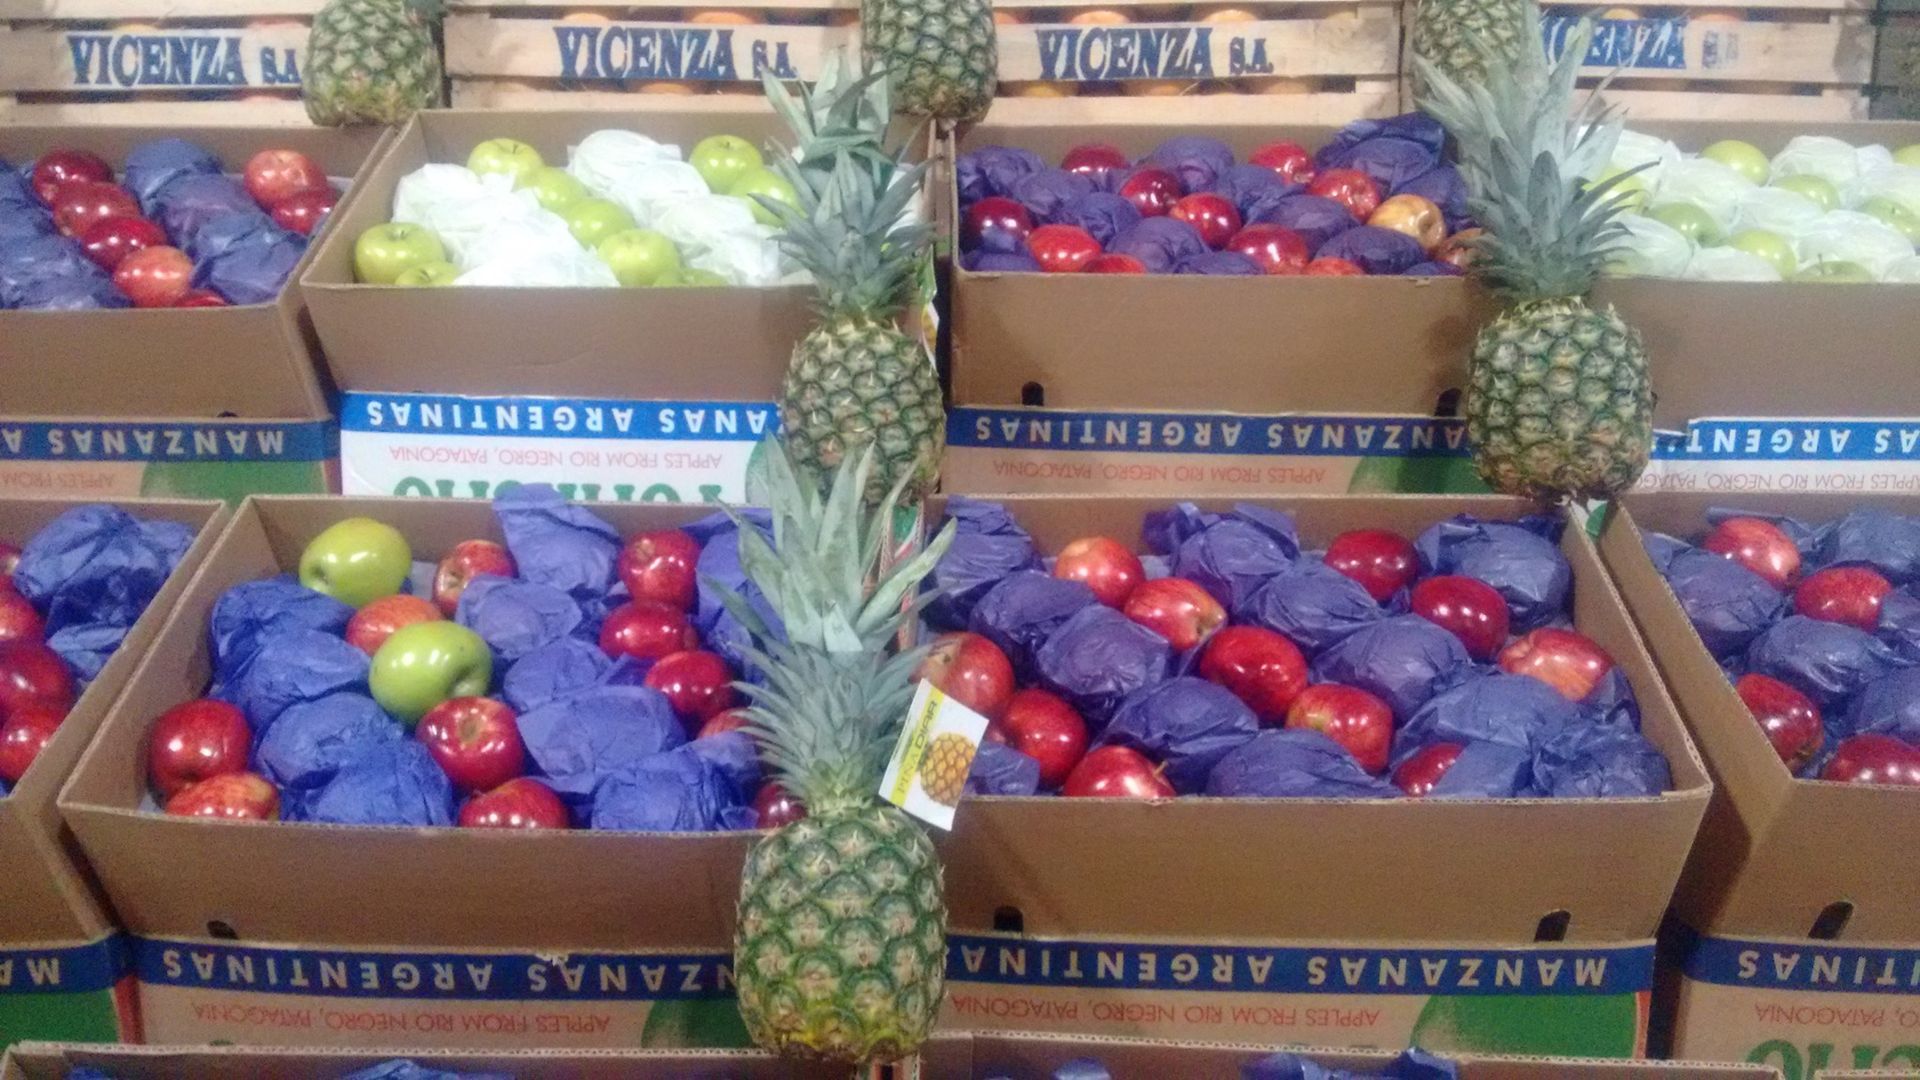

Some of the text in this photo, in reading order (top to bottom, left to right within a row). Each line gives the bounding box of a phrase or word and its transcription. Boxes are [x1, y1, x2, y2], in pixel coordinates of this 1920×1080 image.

[67, 34, 249, 87] VICENZA
[553, 26, 740, 80] VICENZA
[1036, 27, 1214, 80] VICENZA
[368, 400, 783, 434] ANAS ARGENTINAS
[975, 415, 1242, 447] ARGENTINAS
[49, 429, 285, 455] MANZANAS
[389, 445, 723, 469] APPLES FROM RIO NEGRO, PATAGONIA
[993, 460, 1326, 484] APPLES FROM RIO NEGRO, PATAGONIA
[1704, 472, 1773, 490] NEGRO,
[1778, 473, 1808, 490] RIO
[1814, 473, 1865, 490] FROM
[164, 949, 493, 992] ARGENTINAS
[1306, 955, 1608, 987] MANZANAS
[192, 1001, 611, 1034] APPLES FROM RIO NEGRO, PATAGONIA
[952, 995, 1380, 1028] APPLES FROM RIO NEGRO, PATAGONIA
[1755, 1003, 1886, 1027] PATAGONIA
